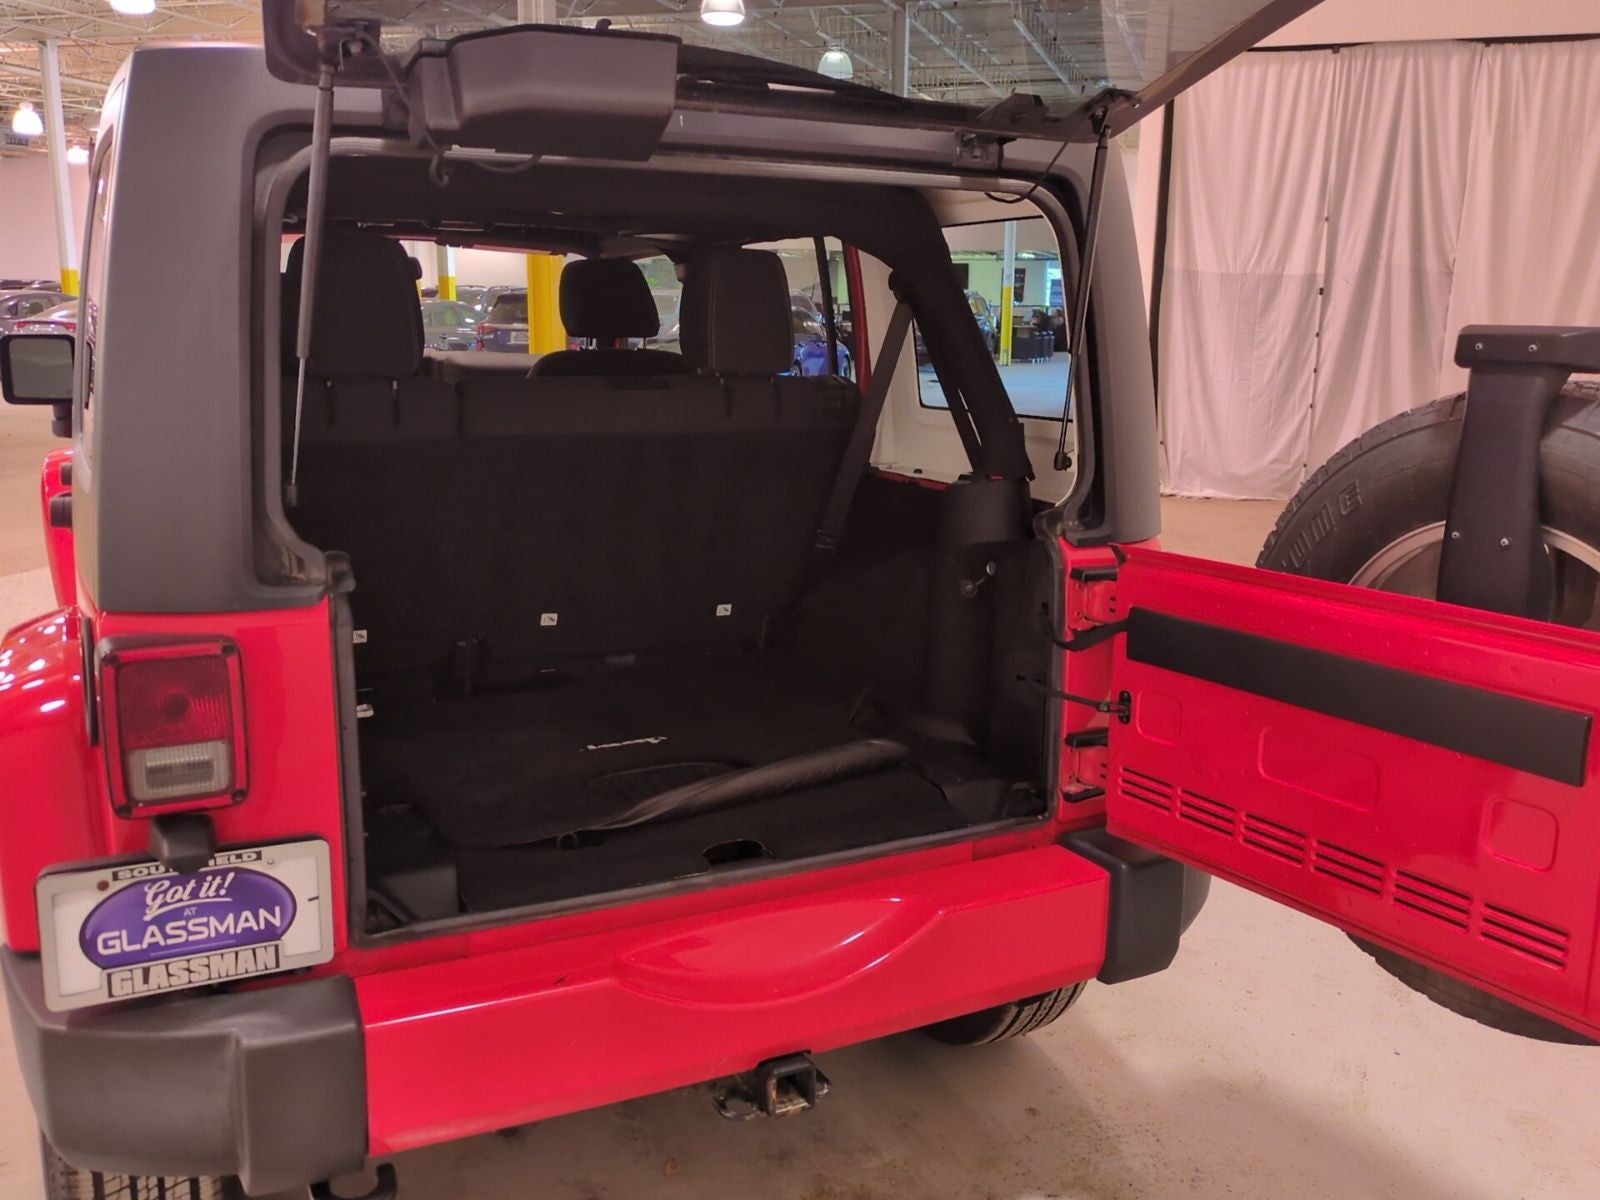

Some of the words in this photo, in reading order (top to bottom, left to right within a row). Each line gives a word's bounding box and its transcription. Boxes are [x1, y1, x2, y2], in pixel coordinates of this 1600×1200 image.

[144, 879, 197, 914] Got
[199, 871, 235, 898] it!
[183, 906, 198, 917] AT
[96, 905, 282, 956] GLASSMAN
[110, 945, 278, 997] GLASSMAN
